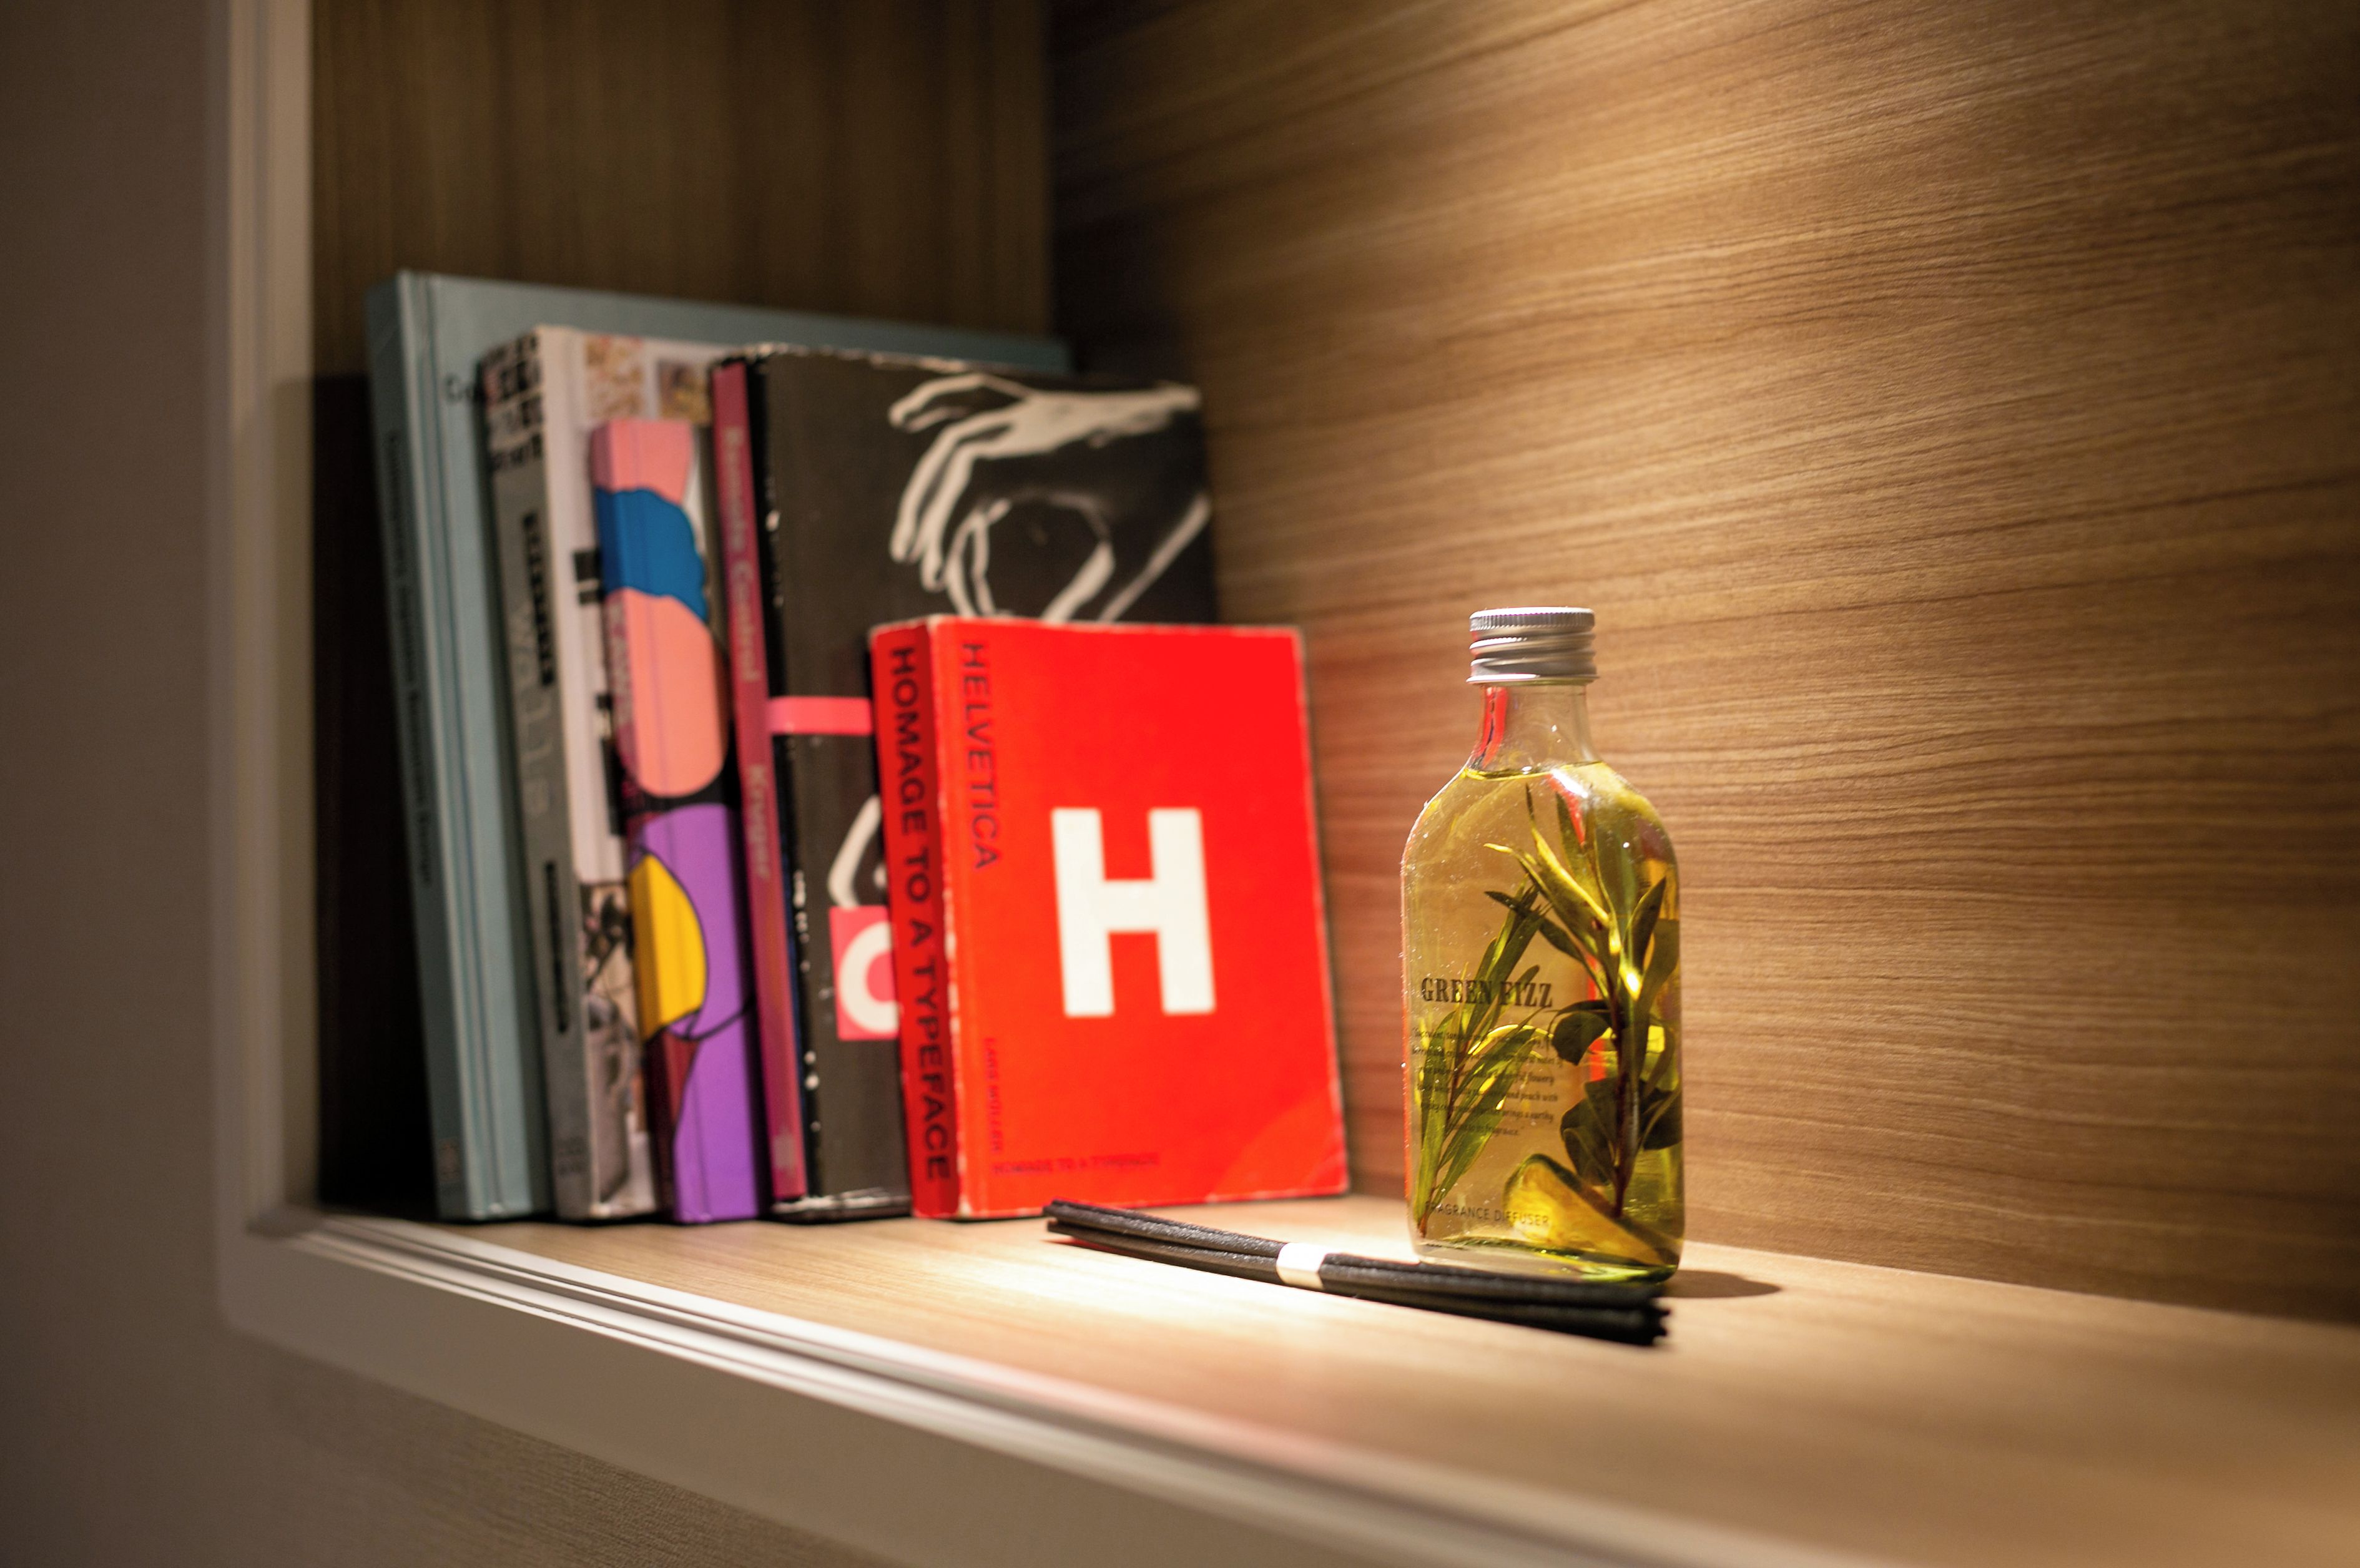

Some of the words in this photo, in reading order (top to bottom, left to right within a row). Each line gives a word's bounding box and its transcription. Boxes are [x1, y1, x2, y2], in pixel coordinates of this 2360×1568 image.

[891, 647, 927, 835] HOMAGE
[962, 643, 1000, 870] HELVETICA
[905, 845, 931, 904] TO
[910, 918, 933, 948] A
[1051, 807, 1216, 1017] H
[1420, 976, 1492, 1005] GREEN
[1500, 981, 1553, 1009] FIZZ
[913, 954, 951, 1180] TYPEFACE
[1425, 1200, 1491, 1221] FRAGRANCE
[1495, 1208, 1550, 1228] DIFFUSER
